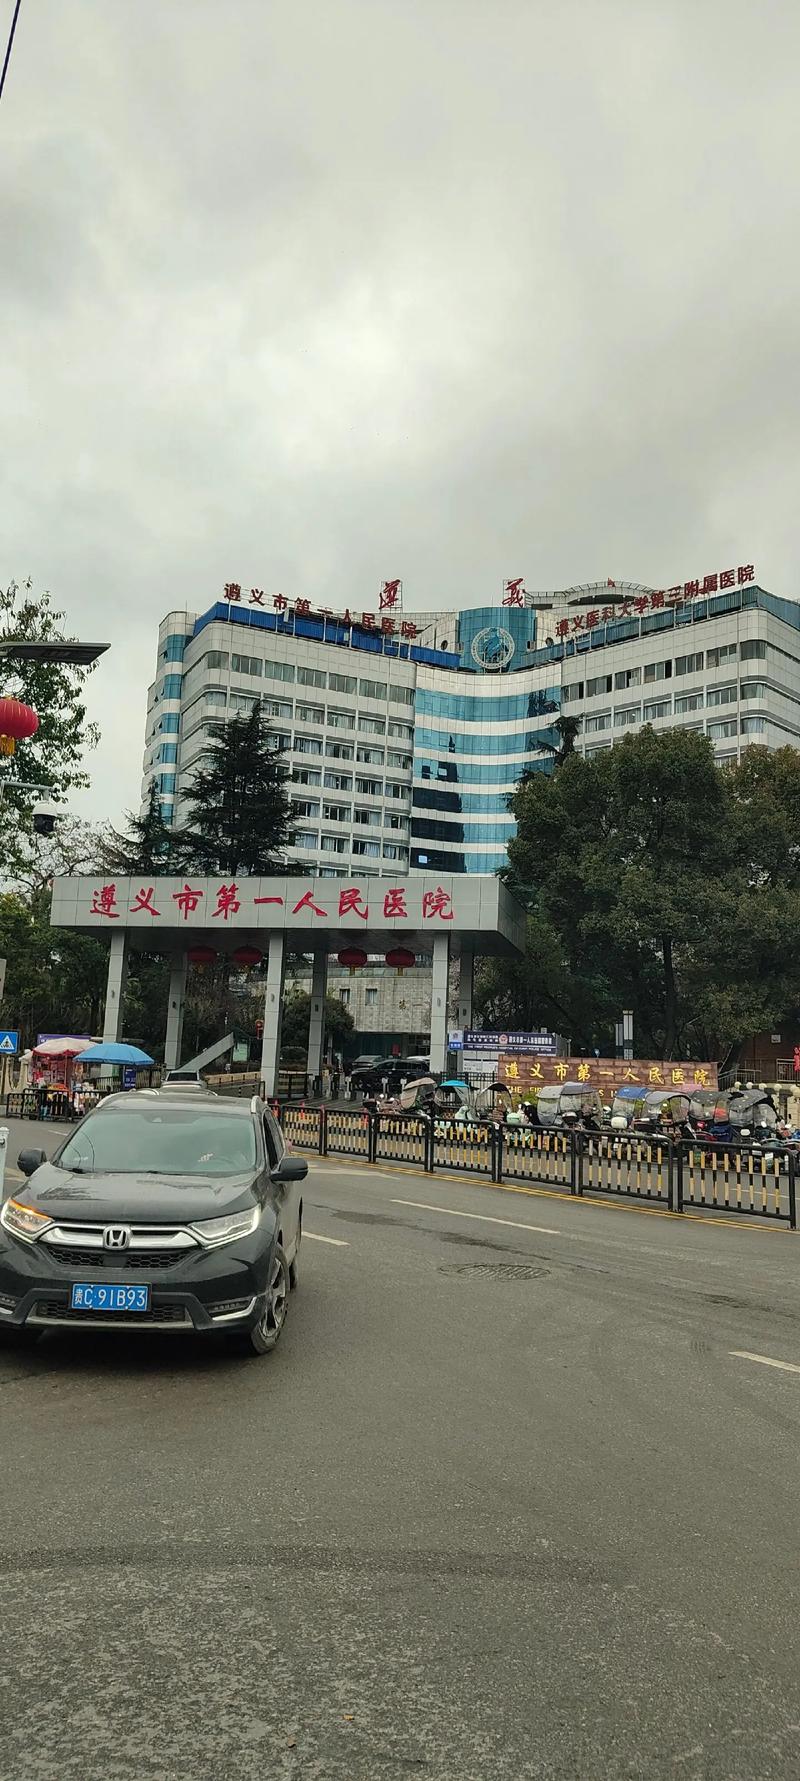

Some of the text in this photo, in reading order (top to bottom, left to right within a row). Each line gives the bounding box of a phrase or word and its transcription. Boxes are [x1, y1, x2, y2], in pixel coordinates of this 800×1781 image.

[223, 582, 418, 639] 遵义市第一人民医院
[555, 564, 755, 638] 遵义医科大学第三附属医院
[89, 882, 455, 921] 遵义市第一人民医院
[504, 1062, 713, 1086] 遵义市第一人民医院
